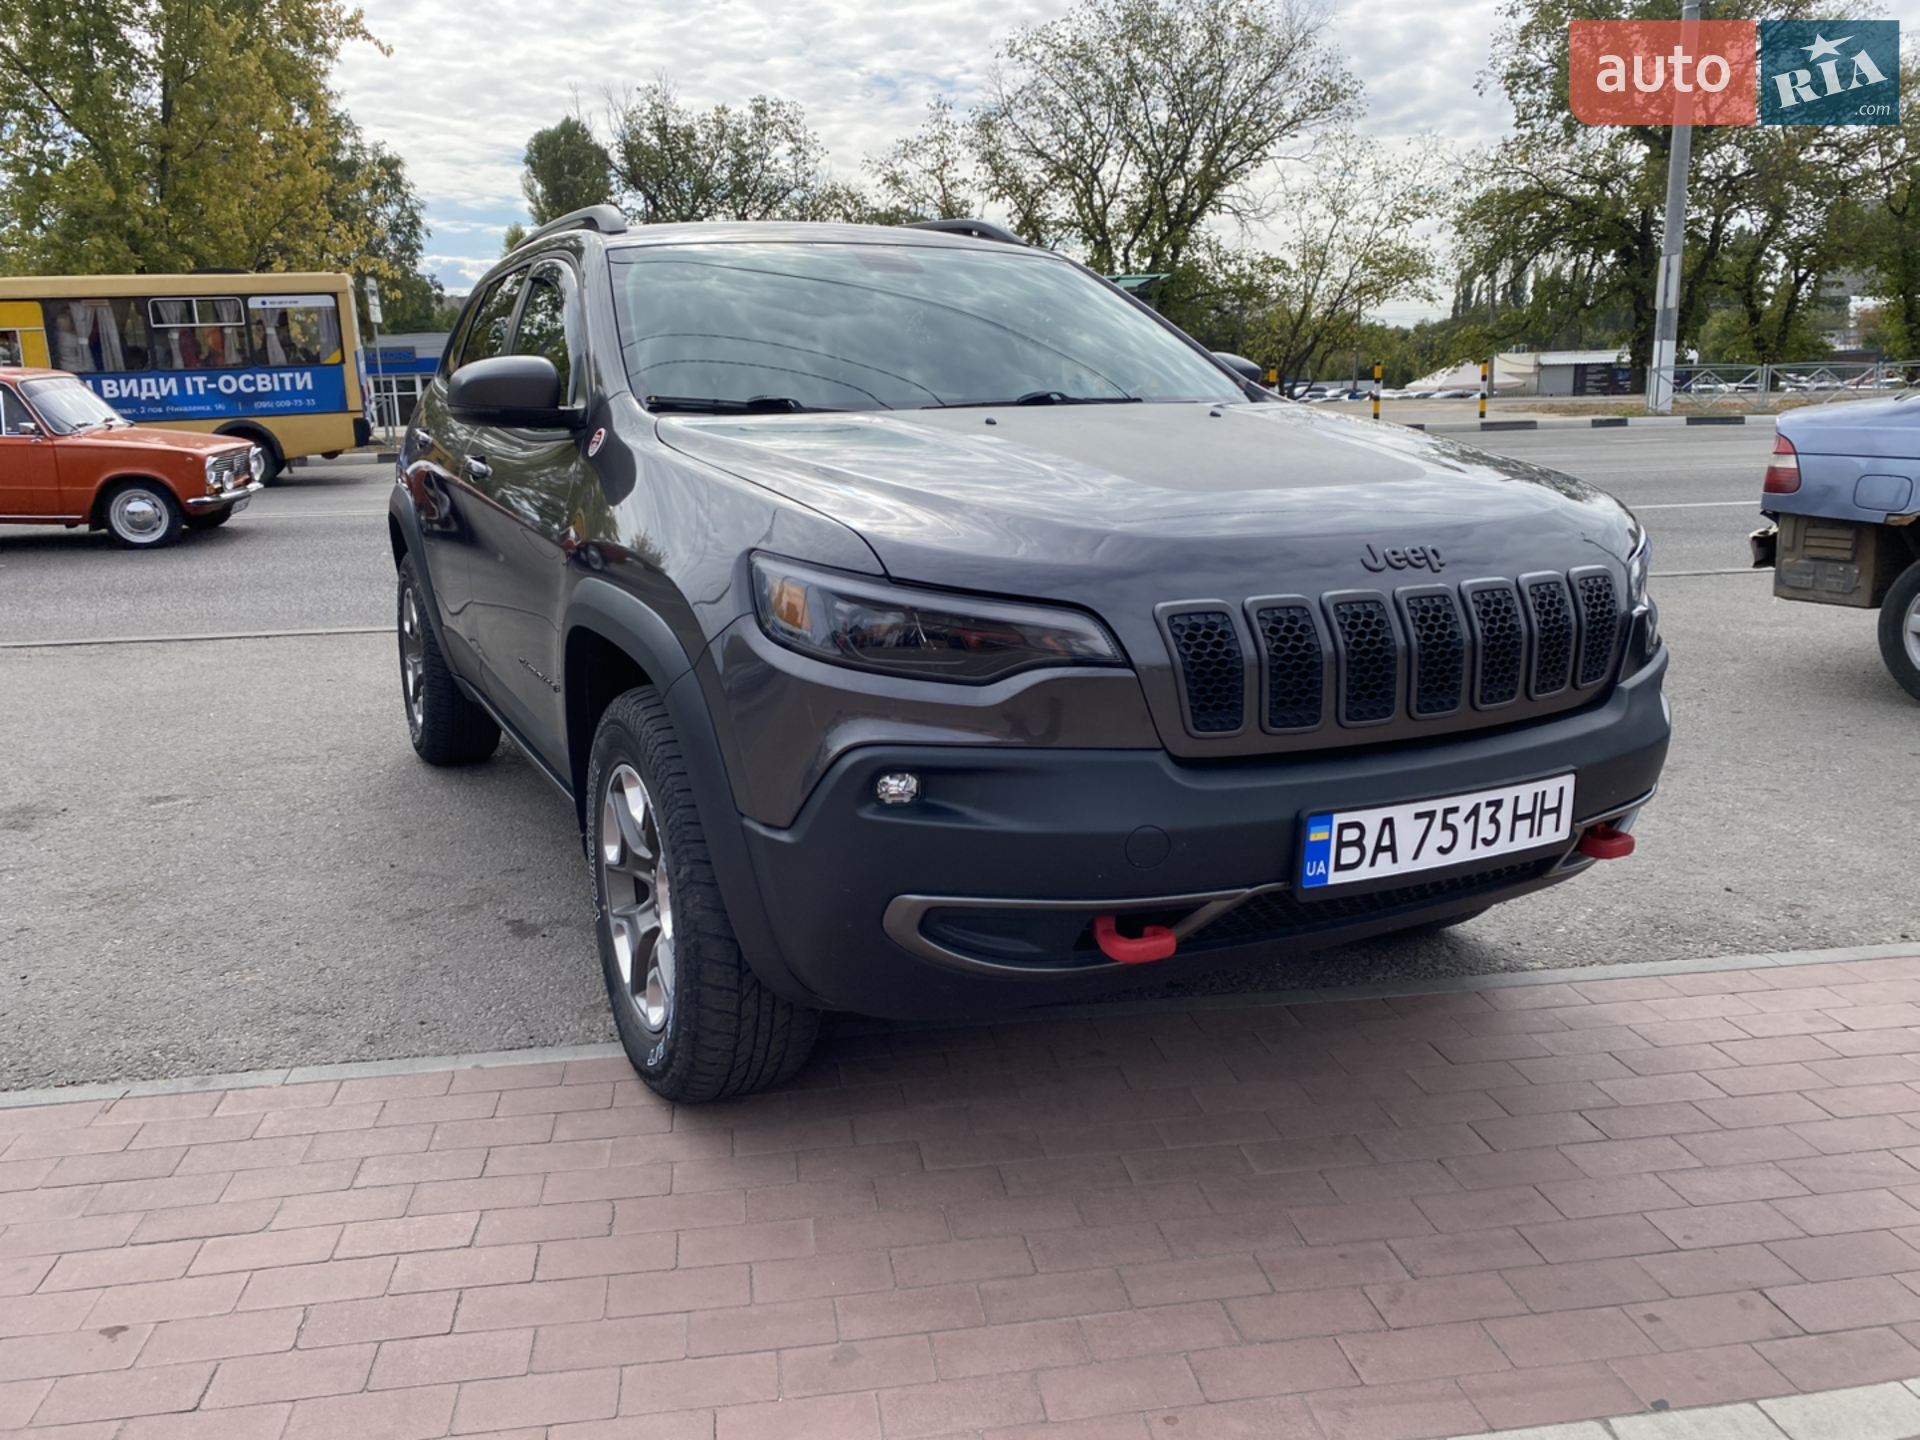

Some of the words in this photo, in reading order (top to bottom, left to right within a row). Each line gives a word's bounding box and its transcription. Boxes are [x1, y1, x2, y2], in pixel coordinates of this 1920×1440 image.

[101, 377, 179, 400] ВИДИ
[140, 406, 146, 414] 2
[1360, 543, 1446, 574] Jeep
[1333, 817, 1399, 873] BA
[1411, 798, 1504, 861] 7513
[1509, 785, 1565, 843] HH
[1306, 859, 1327, 876] UA
